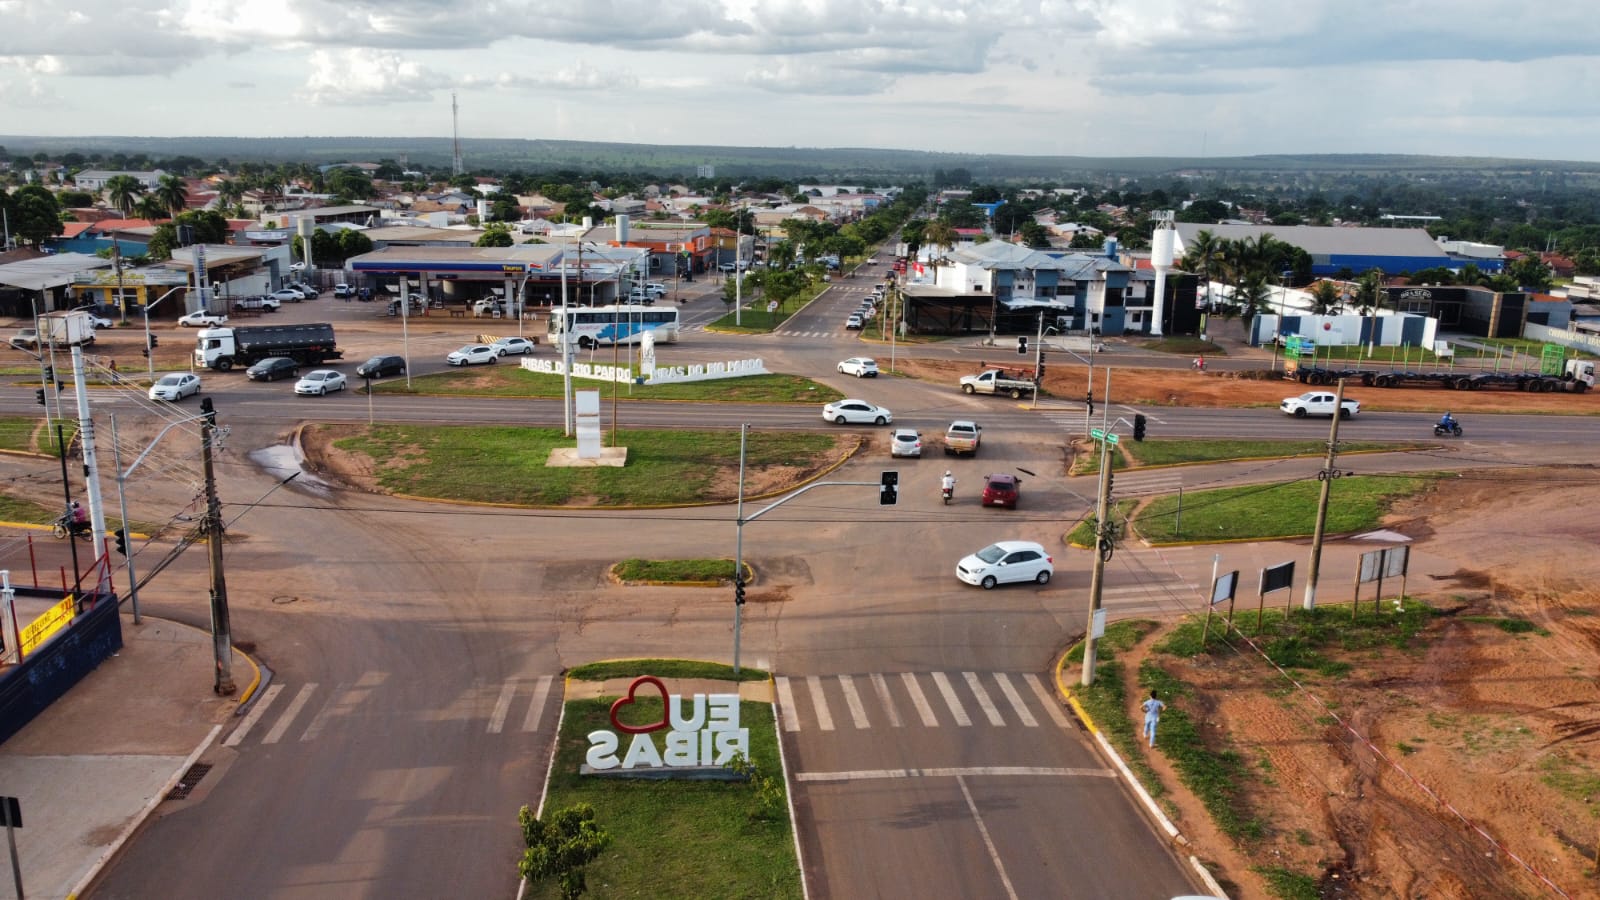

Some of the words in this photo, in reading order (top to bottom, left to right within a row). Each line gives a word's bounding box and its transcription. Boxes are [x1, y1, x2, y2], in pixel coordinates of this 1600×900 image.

[521, 357, 552, 373] RIBAS
[573, 363, 592, 377] RIO
[594, 365, 632, 381] PARDO
[688, 364, 704, 376] DO
[707, 361, 725, 374] RIO
[728, 358, 763, 372] PARDO
